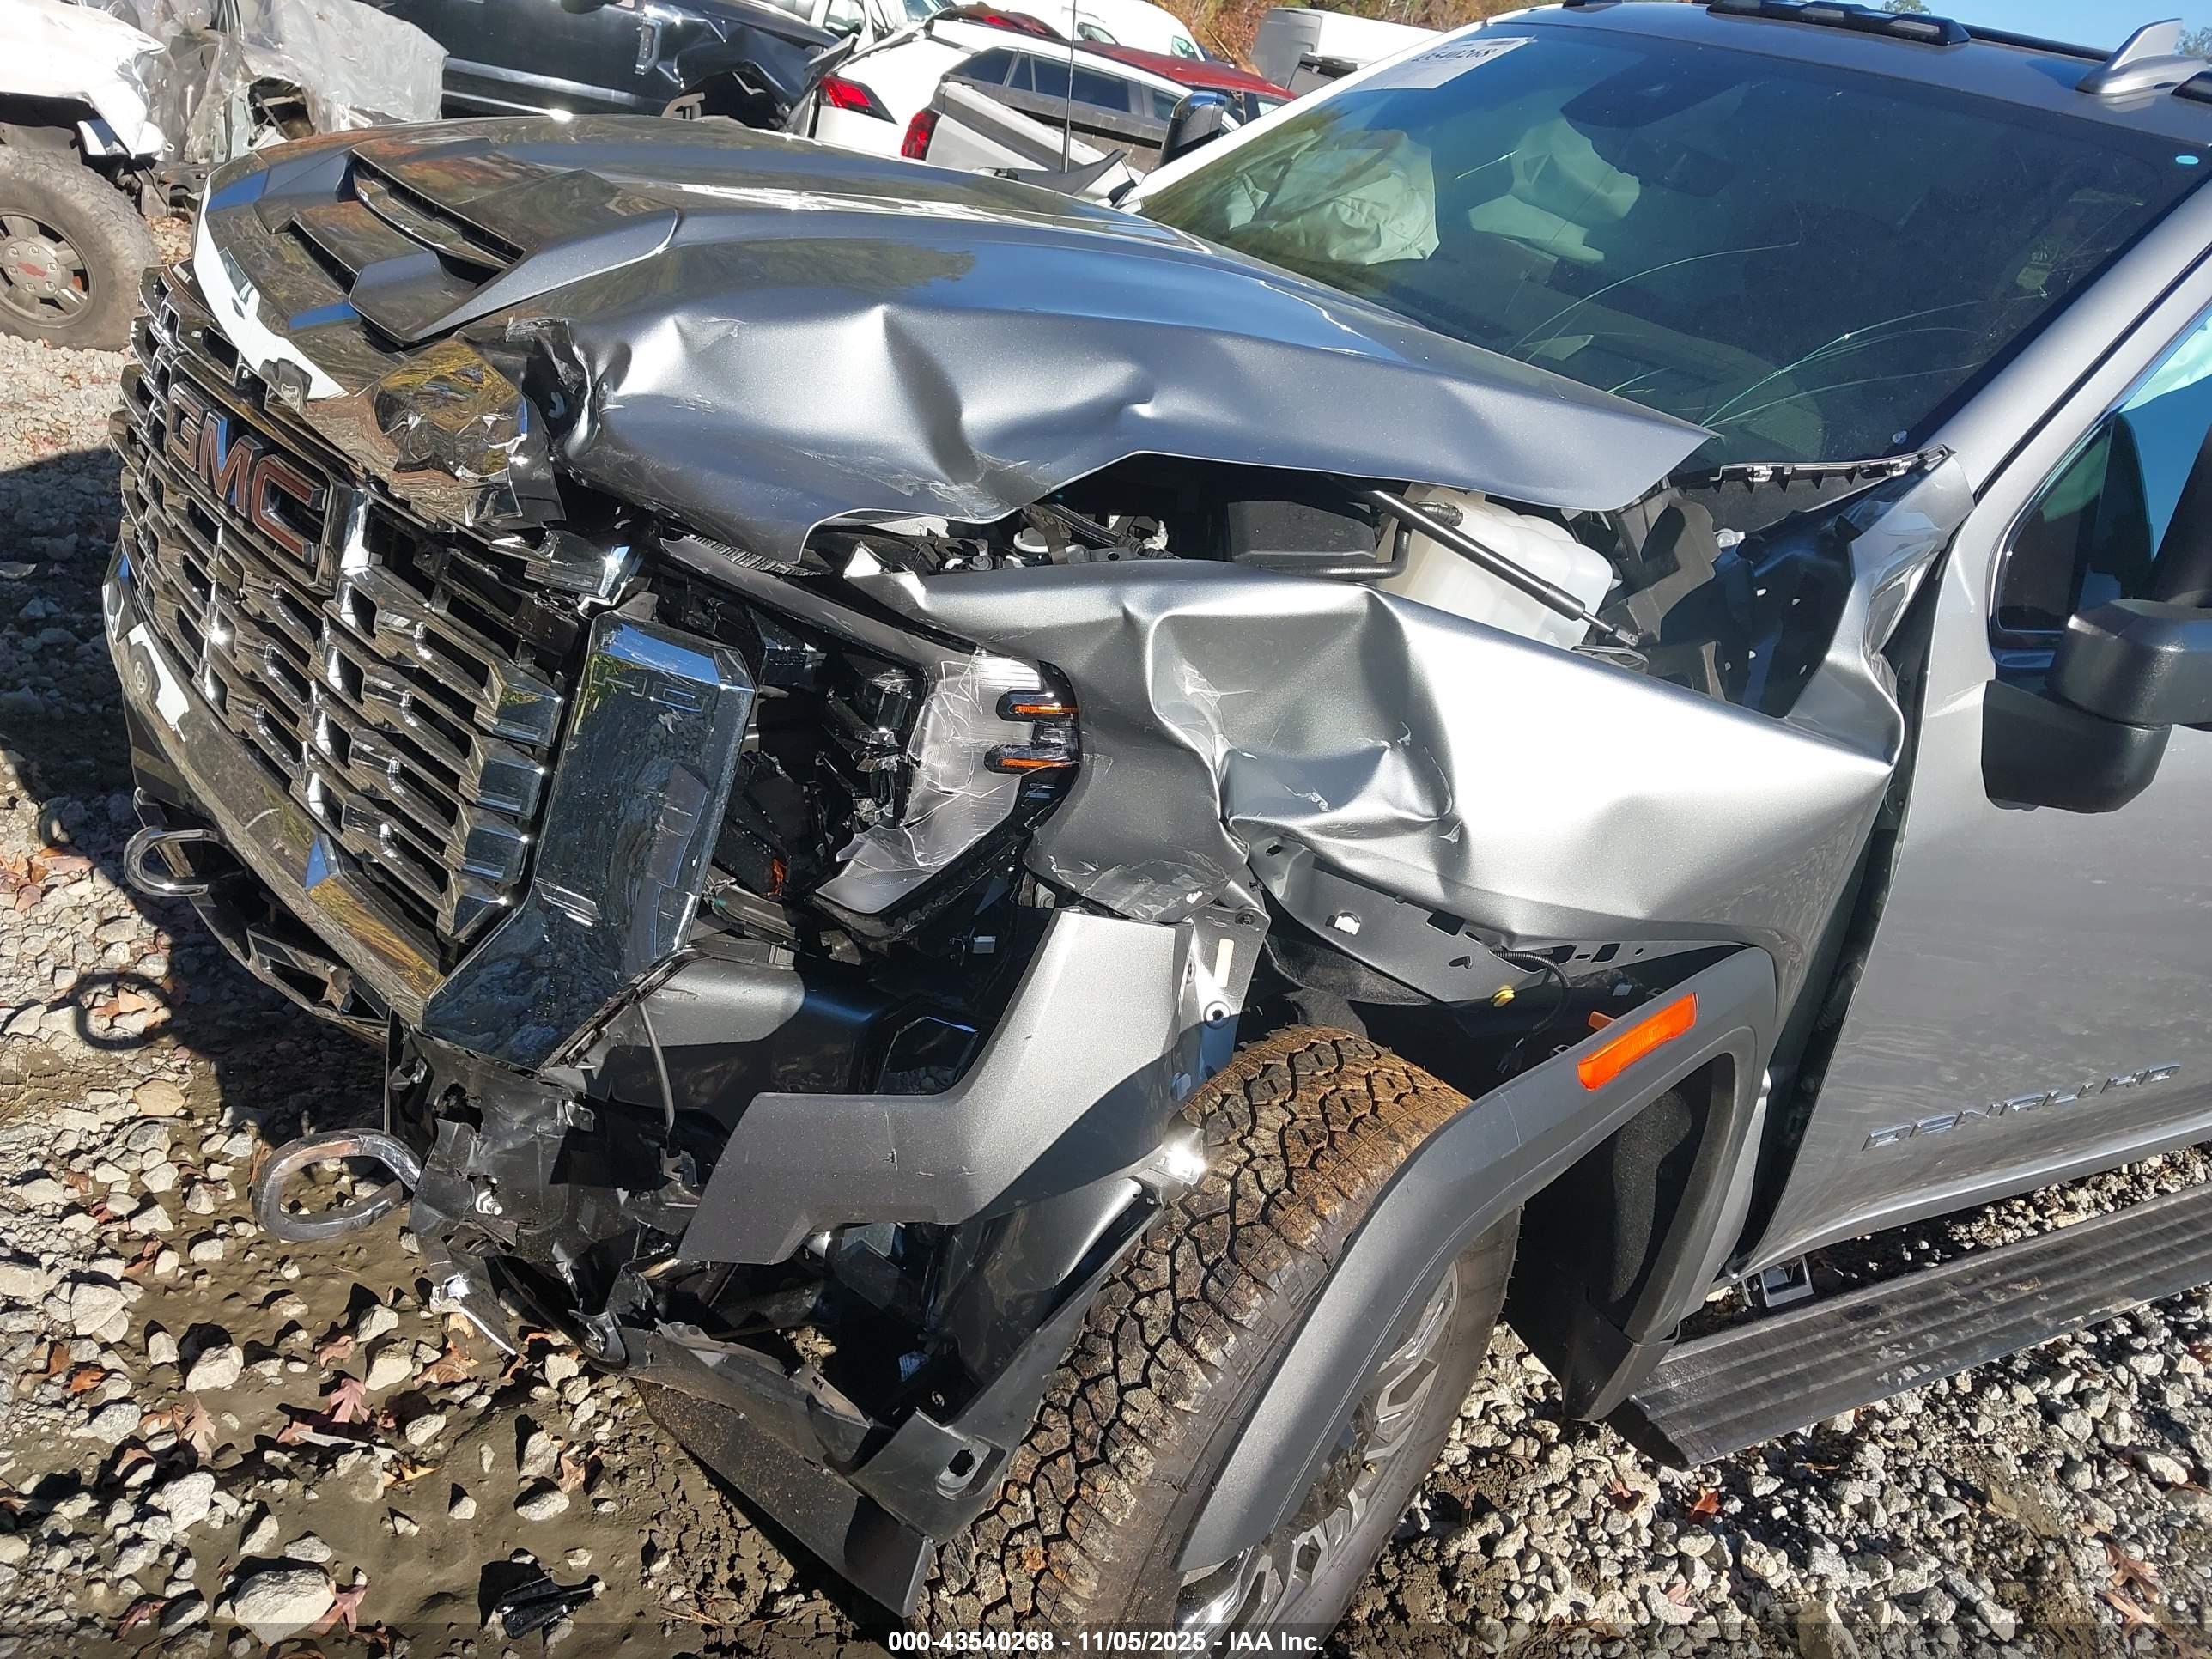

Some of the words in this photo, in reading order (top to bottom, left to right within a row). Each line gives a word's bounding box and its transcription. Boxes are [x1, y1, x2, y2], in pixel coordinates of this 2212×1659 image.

[166, 380, 327, 567] GMC
[1862, 1083, 2094, 1152] DENALI
[2100, 1064, 2181, 1095] HD
